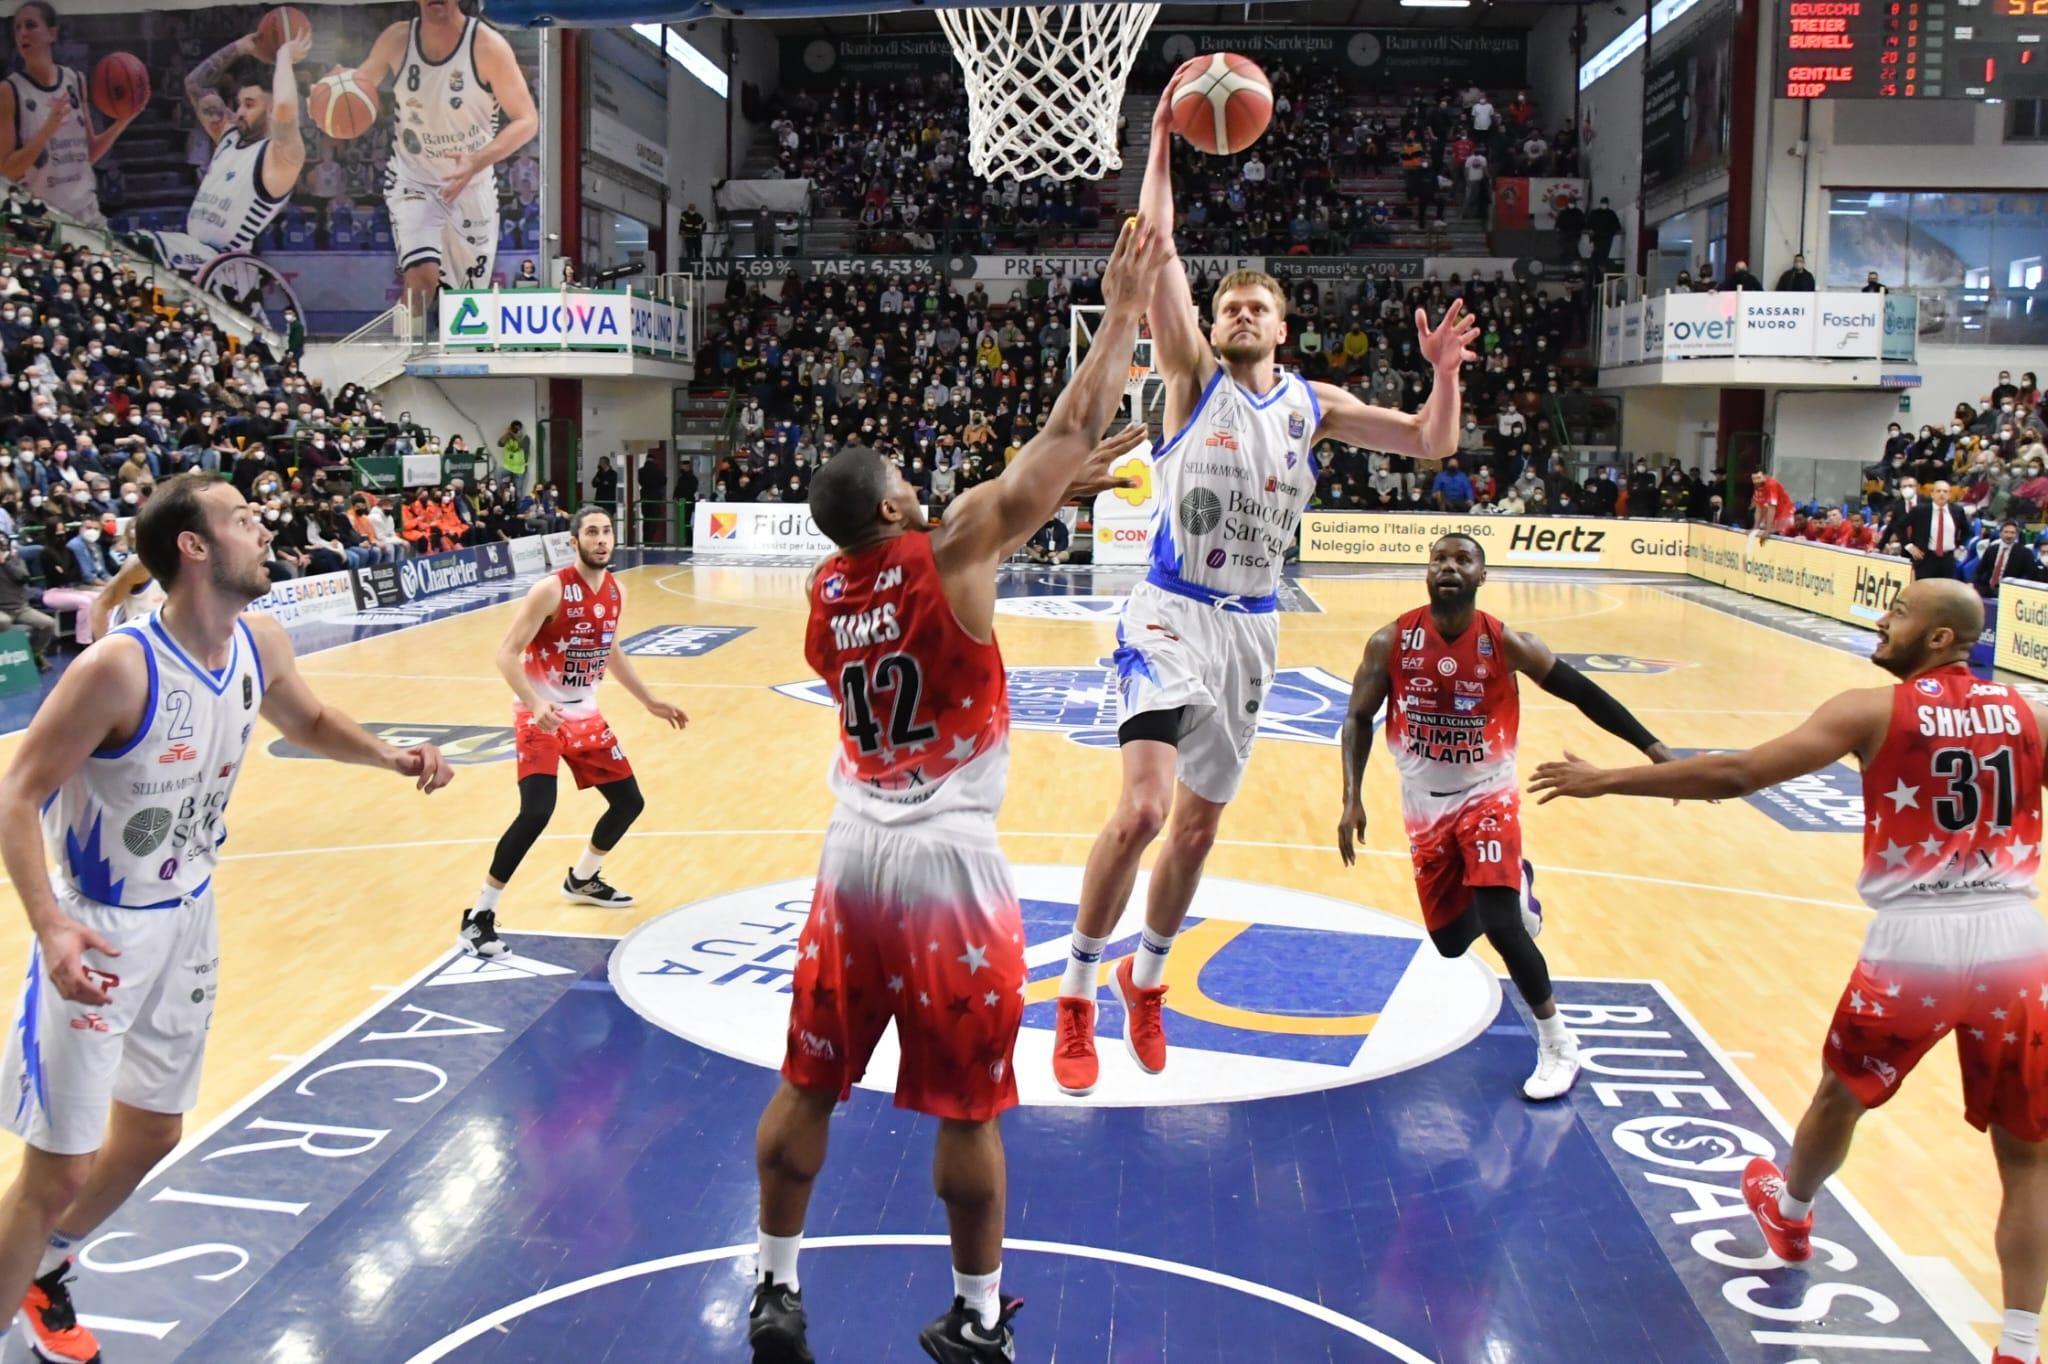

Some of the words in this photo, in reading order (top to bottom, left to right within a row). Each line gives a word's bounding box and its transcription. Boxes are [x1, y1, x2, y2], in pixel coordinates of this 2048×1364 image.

[1790, 2, 1860, 16] DEVECCHI
[1790, 18, 1847, 32] TREIER
[1200, 35, 1246, 50] Banco
[1248, 34, 1262, 50] di
[1264, 34, 1333, 53] Sardegna
[1385, 35, 1433, 50] Banco
[1434, 34, 1448, 50] di
[1450, 34, 1520, 53] Sardegna
[1788, 34, 1854, 48] BURNELL
[1880, 51, 1899, 64] 20
[407, 64, 420, 92] 8
[1787, 66, 1854, 80] GENTILE
[1786, 82, 1827, 97] DIOP
[421, 130, 466, 146] Banco
[690, 260, 730, 275] TAN
[1748, 307, 1805, 316] SASSARI
[501, 305, 618, 335] NUOVA
[1748, 320, 1796, 329] NUORO
[1823, 312, 1876, 328] Foschi
[1311, 521, 1381, 534] Guidiamo
[1383, 522, 1427, 536] l'Italia
[1457, 525, 1496, 537] 1960.
[1509, 523, 1606, 553] Hertz
[817, 543, 832, 551] tua
[1310, 539, 1375, 556] Noleggio
[1379, 542, 1412, 554] auto
[1414, 545, 1425, 554] e
[417, 556, 478, 594] Character
[563, 583, 584, 602] 40
[1853, 564, 1902, 612] Hertz
[830, 602, 901, 651] HINES
[1400, 627, 1426, 651] 50
[1401, 657, 1425, 669] EA7
[840, 650, 939, 757] 42
[1454, 699, 1477, 711] SAP
[165, 689, 194, 741] 2
[1406, 713, 1437, 724] ARMANI
[1440, 716, 1485, 727] EXCHANGE
[1930, 745, 2016, 833] 31
